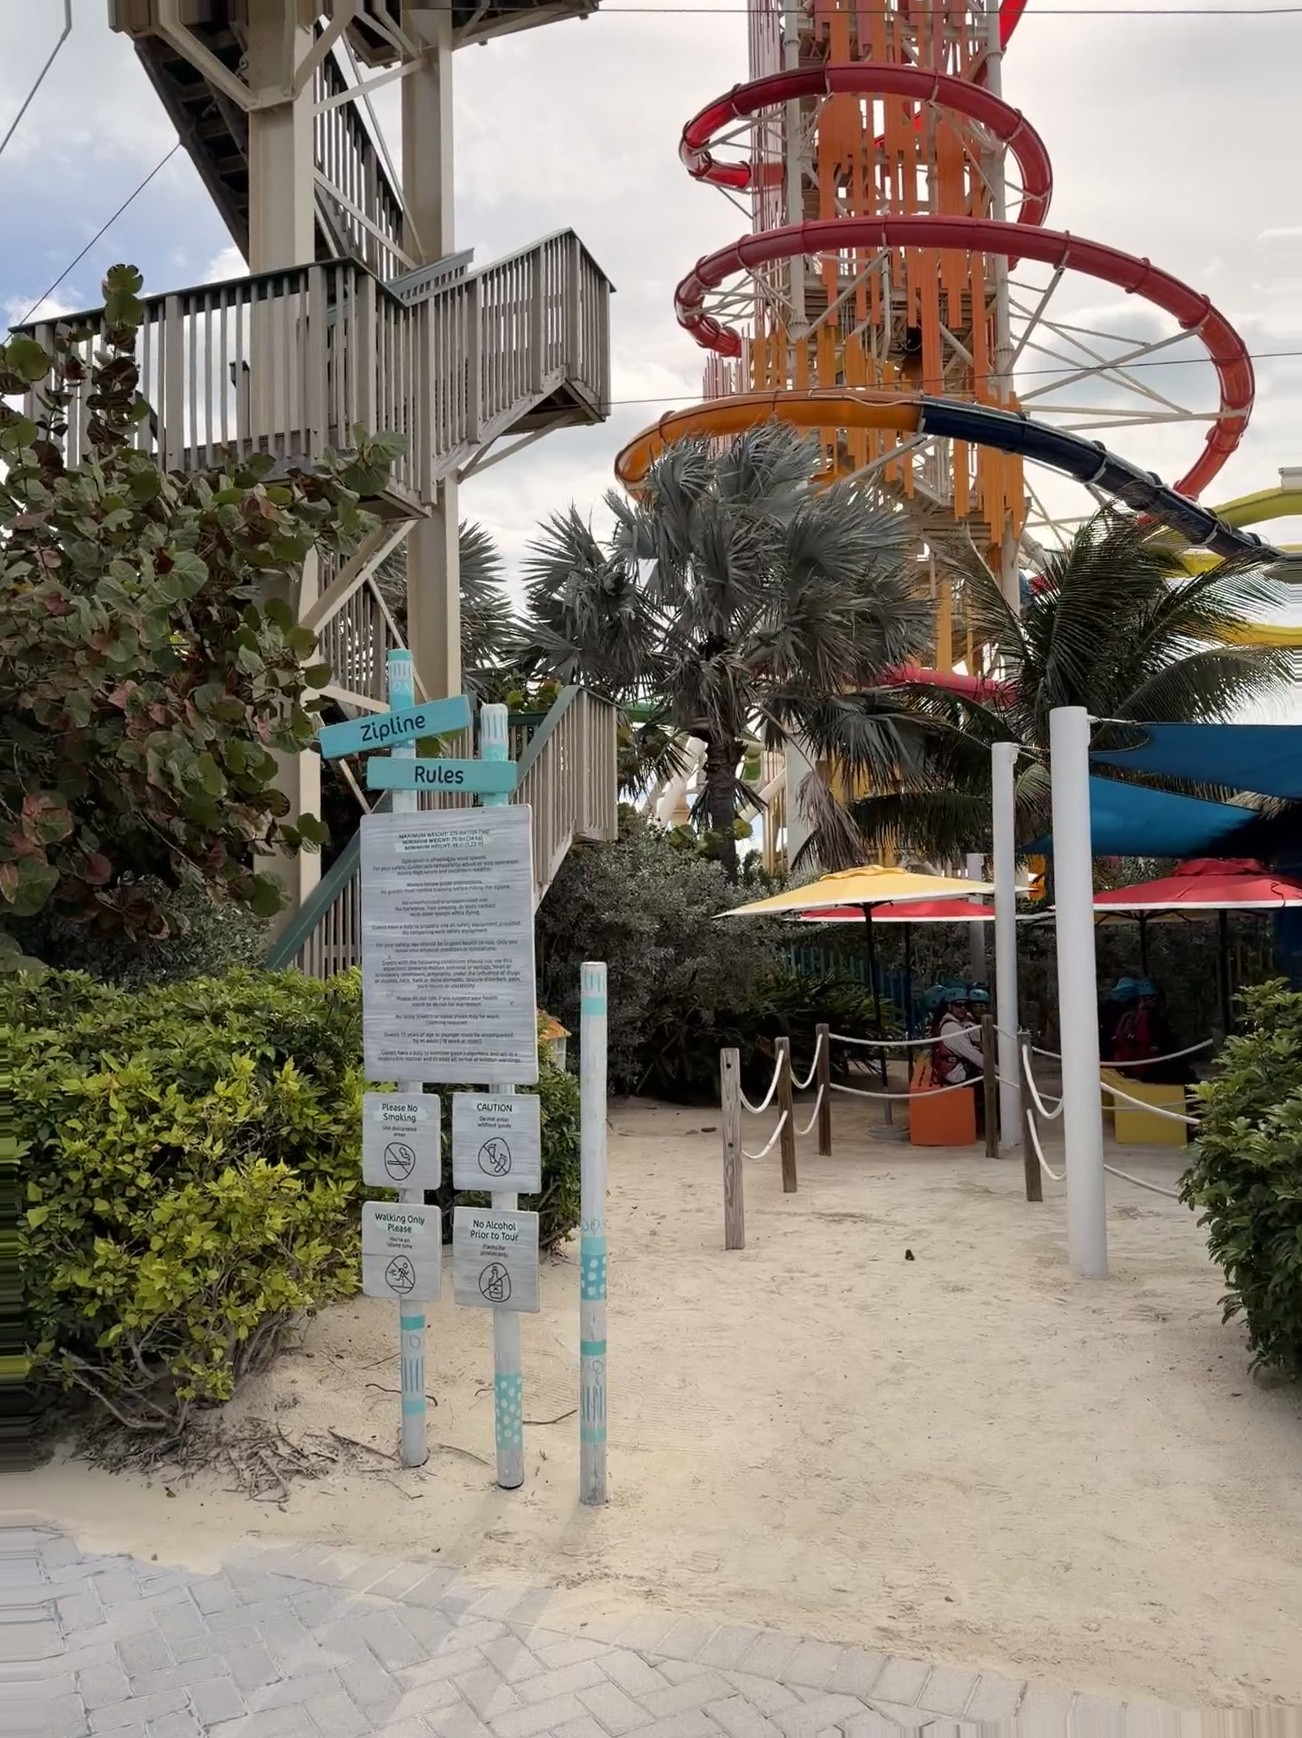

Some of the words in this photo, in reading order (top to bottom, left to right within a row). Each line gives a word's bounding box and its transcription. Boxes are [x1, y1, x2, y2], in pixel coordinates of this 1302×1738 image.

[361, 715, 425, 742] Zipline
[414, 765, 464, 784] Rules
[382, 1103, 405, 1112] Please
[407, 1104, 418, 1112] No
[477, 1103, 513, 1112] CAUTION
[383, 1113, 416, 1124] Smoking
[375, 1213, 405, 1224] Walking
[407, 1215, 425, 1225] Only
[388, 1224, 412, 1233] Please
[473, 1219, 485, 1228] No
[486, 1220, 516, 1231] Alcohol
[470, 1230, 489, 1239] Prior
[490, 1231, 500, 1240] to
[501, 1232, 519, 1241] Tour
